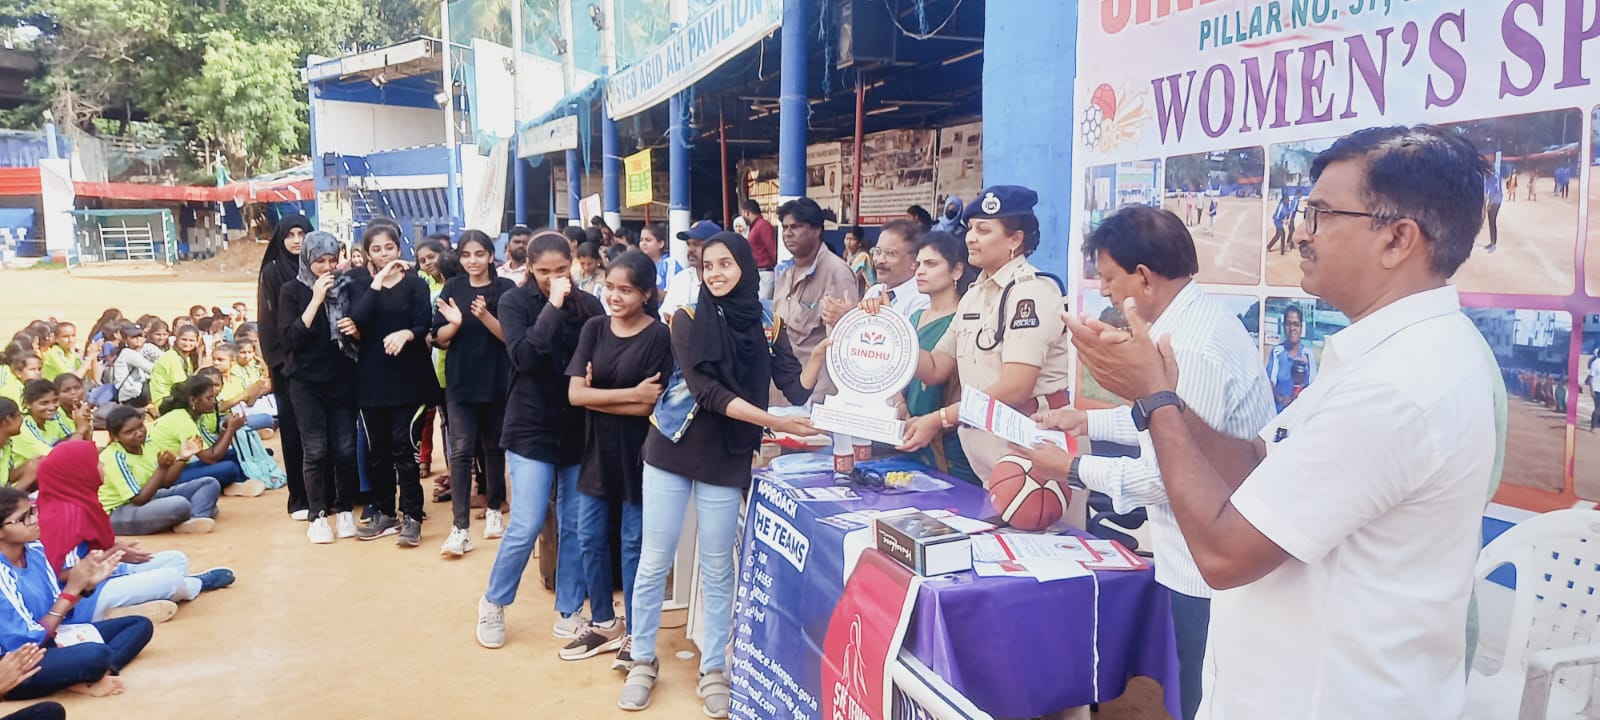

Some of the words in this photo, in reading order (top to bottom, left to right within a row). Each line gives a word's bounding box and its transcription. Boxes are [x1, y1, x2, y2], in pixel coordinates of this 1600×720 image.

[1199, 7, 1282, 50] PILLAR
[1291, 0, 1338, 29] NO.
[616, 72, 637, 104] SYED
[640, 53, 663, 93] ABID
[667, 33, 685, 77] ALI
[850, 347, 890, 361] SINDHU
[758, 480, 798, 519] APPROACH
[757, 511, 771, 536] HE
[773, 522, 805, 563] TEAMS
